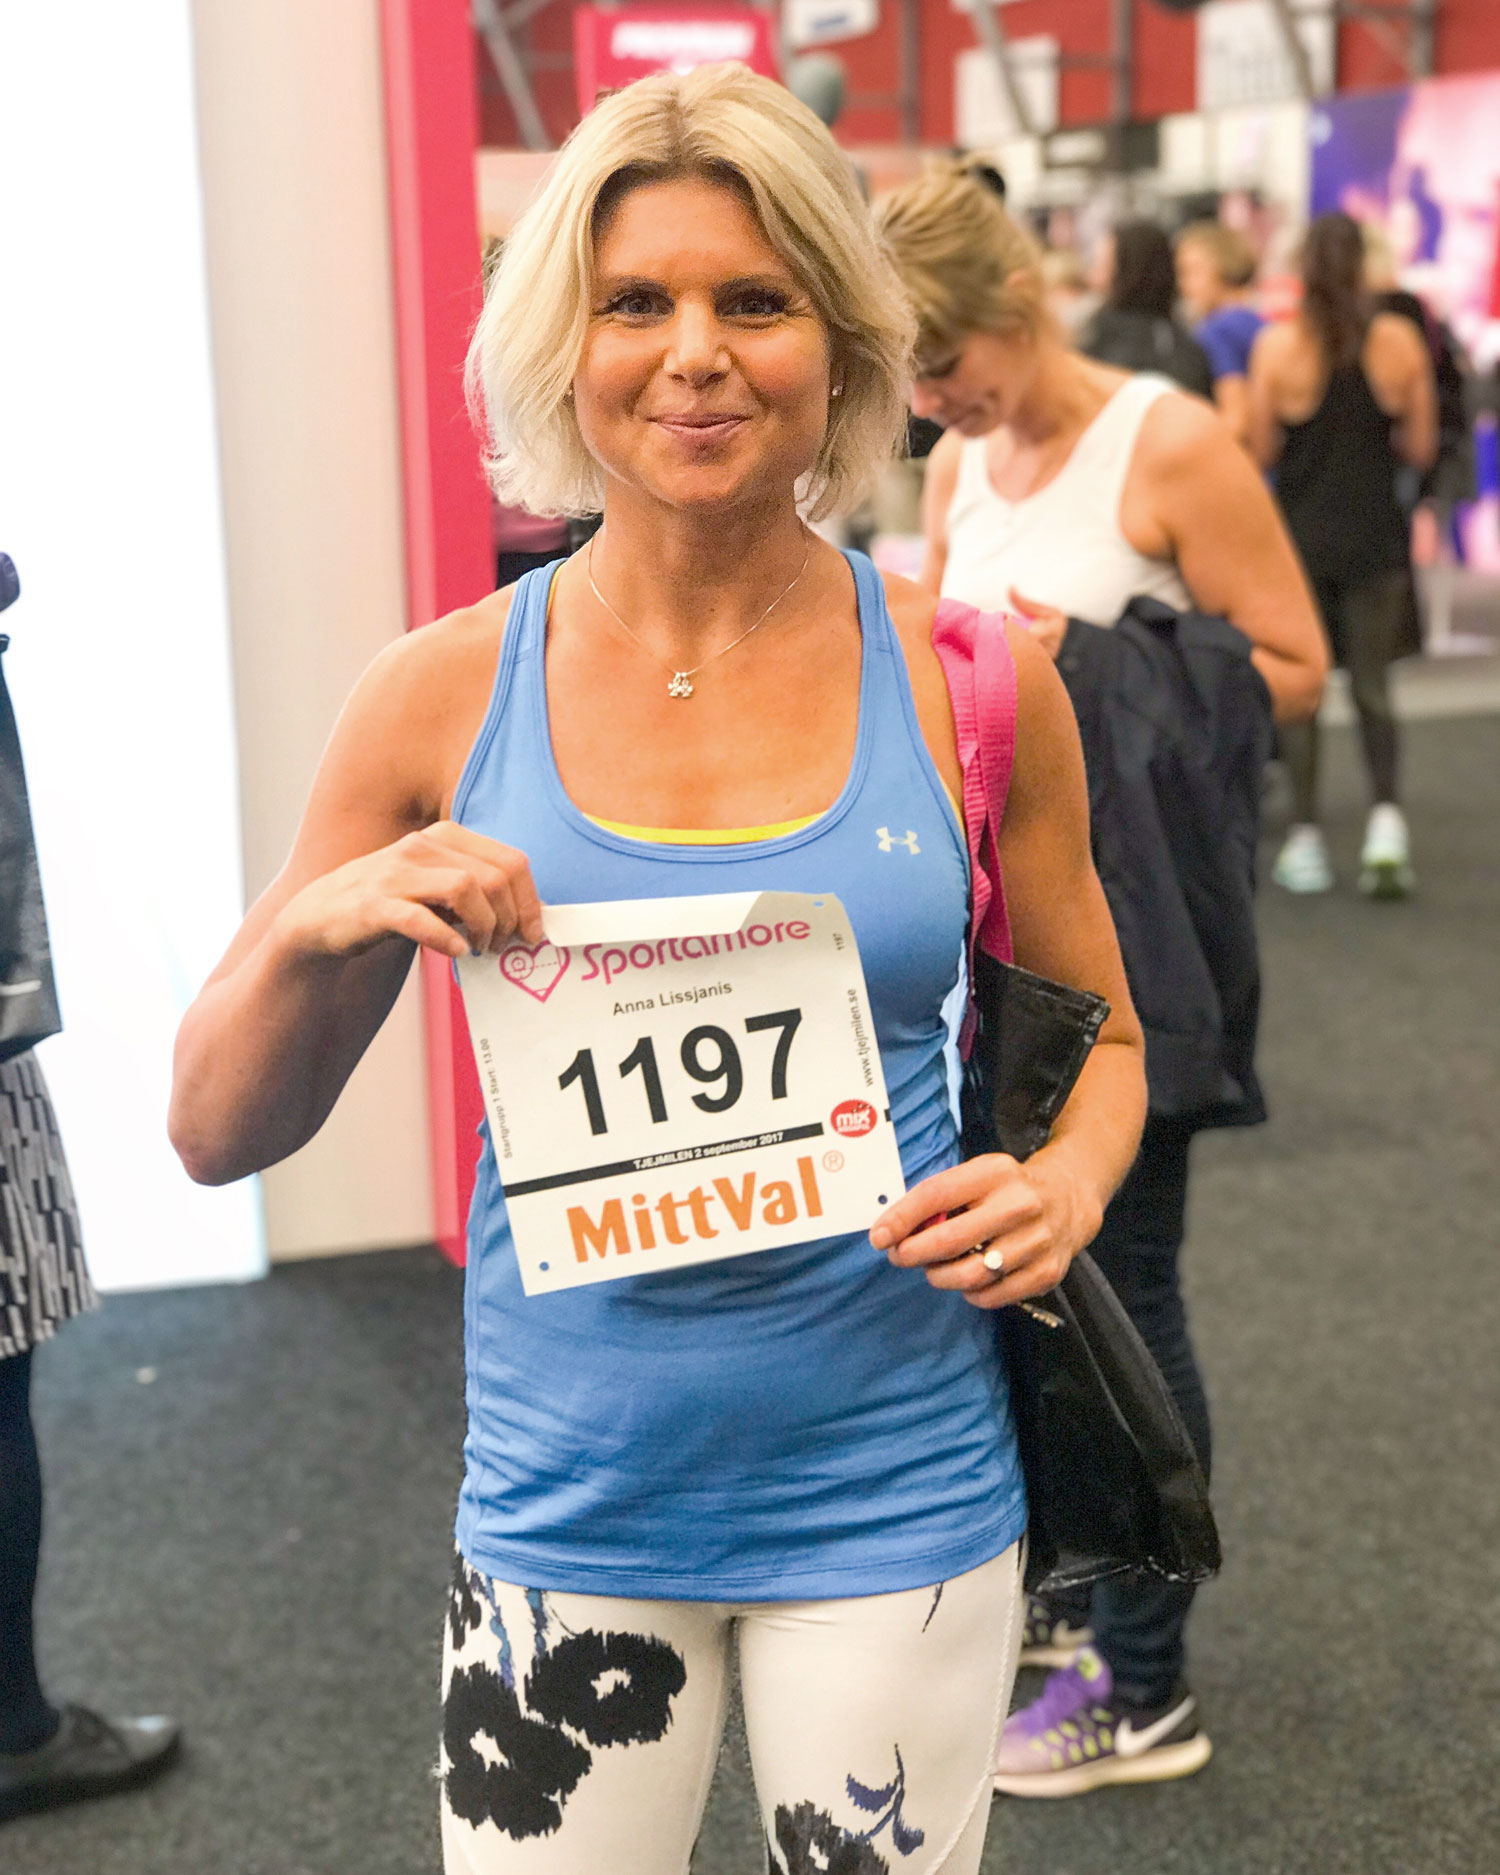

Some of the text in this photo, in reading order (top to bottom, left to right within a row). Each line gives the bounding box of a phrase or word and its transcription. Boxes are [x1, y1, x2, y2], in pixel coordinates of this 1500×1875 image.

[581, 920, 811, 985] Sportamore
[613, 981, 733, 1016] Anna Lissjanis
[847, 988, 874, 1088] www.tjejmilen.se
[557, 1008, 803, 1136] 1197
[496, 1105, 513, 1159] Startgrupp
[633, 1131, 784, 1170] TJEJMILEN 2 september 2017
[566, 1155, 824, 1263] MittVal
